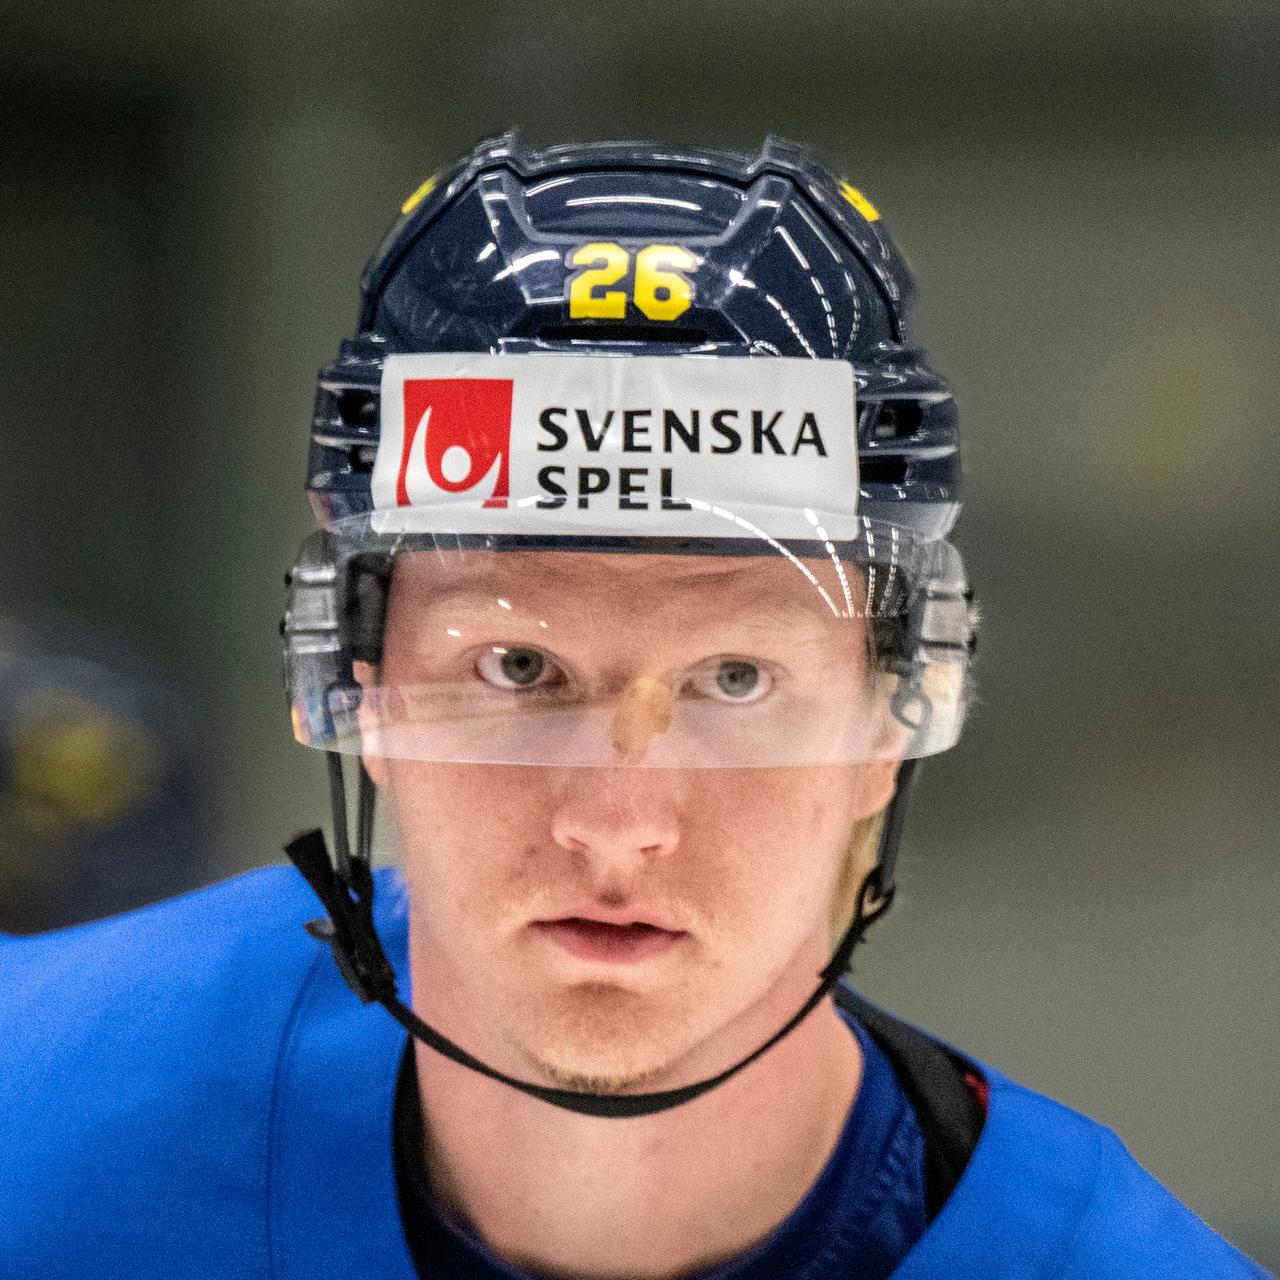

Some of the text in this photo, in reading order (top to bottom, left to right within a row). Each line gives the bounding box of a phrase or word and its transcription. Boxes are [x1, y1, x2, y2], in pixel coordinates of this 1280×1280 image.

[568, 242, 695, 321] 26
[536, 407, 828, 457] SVENSKA
[535, 465, 692, 511] SPEL
